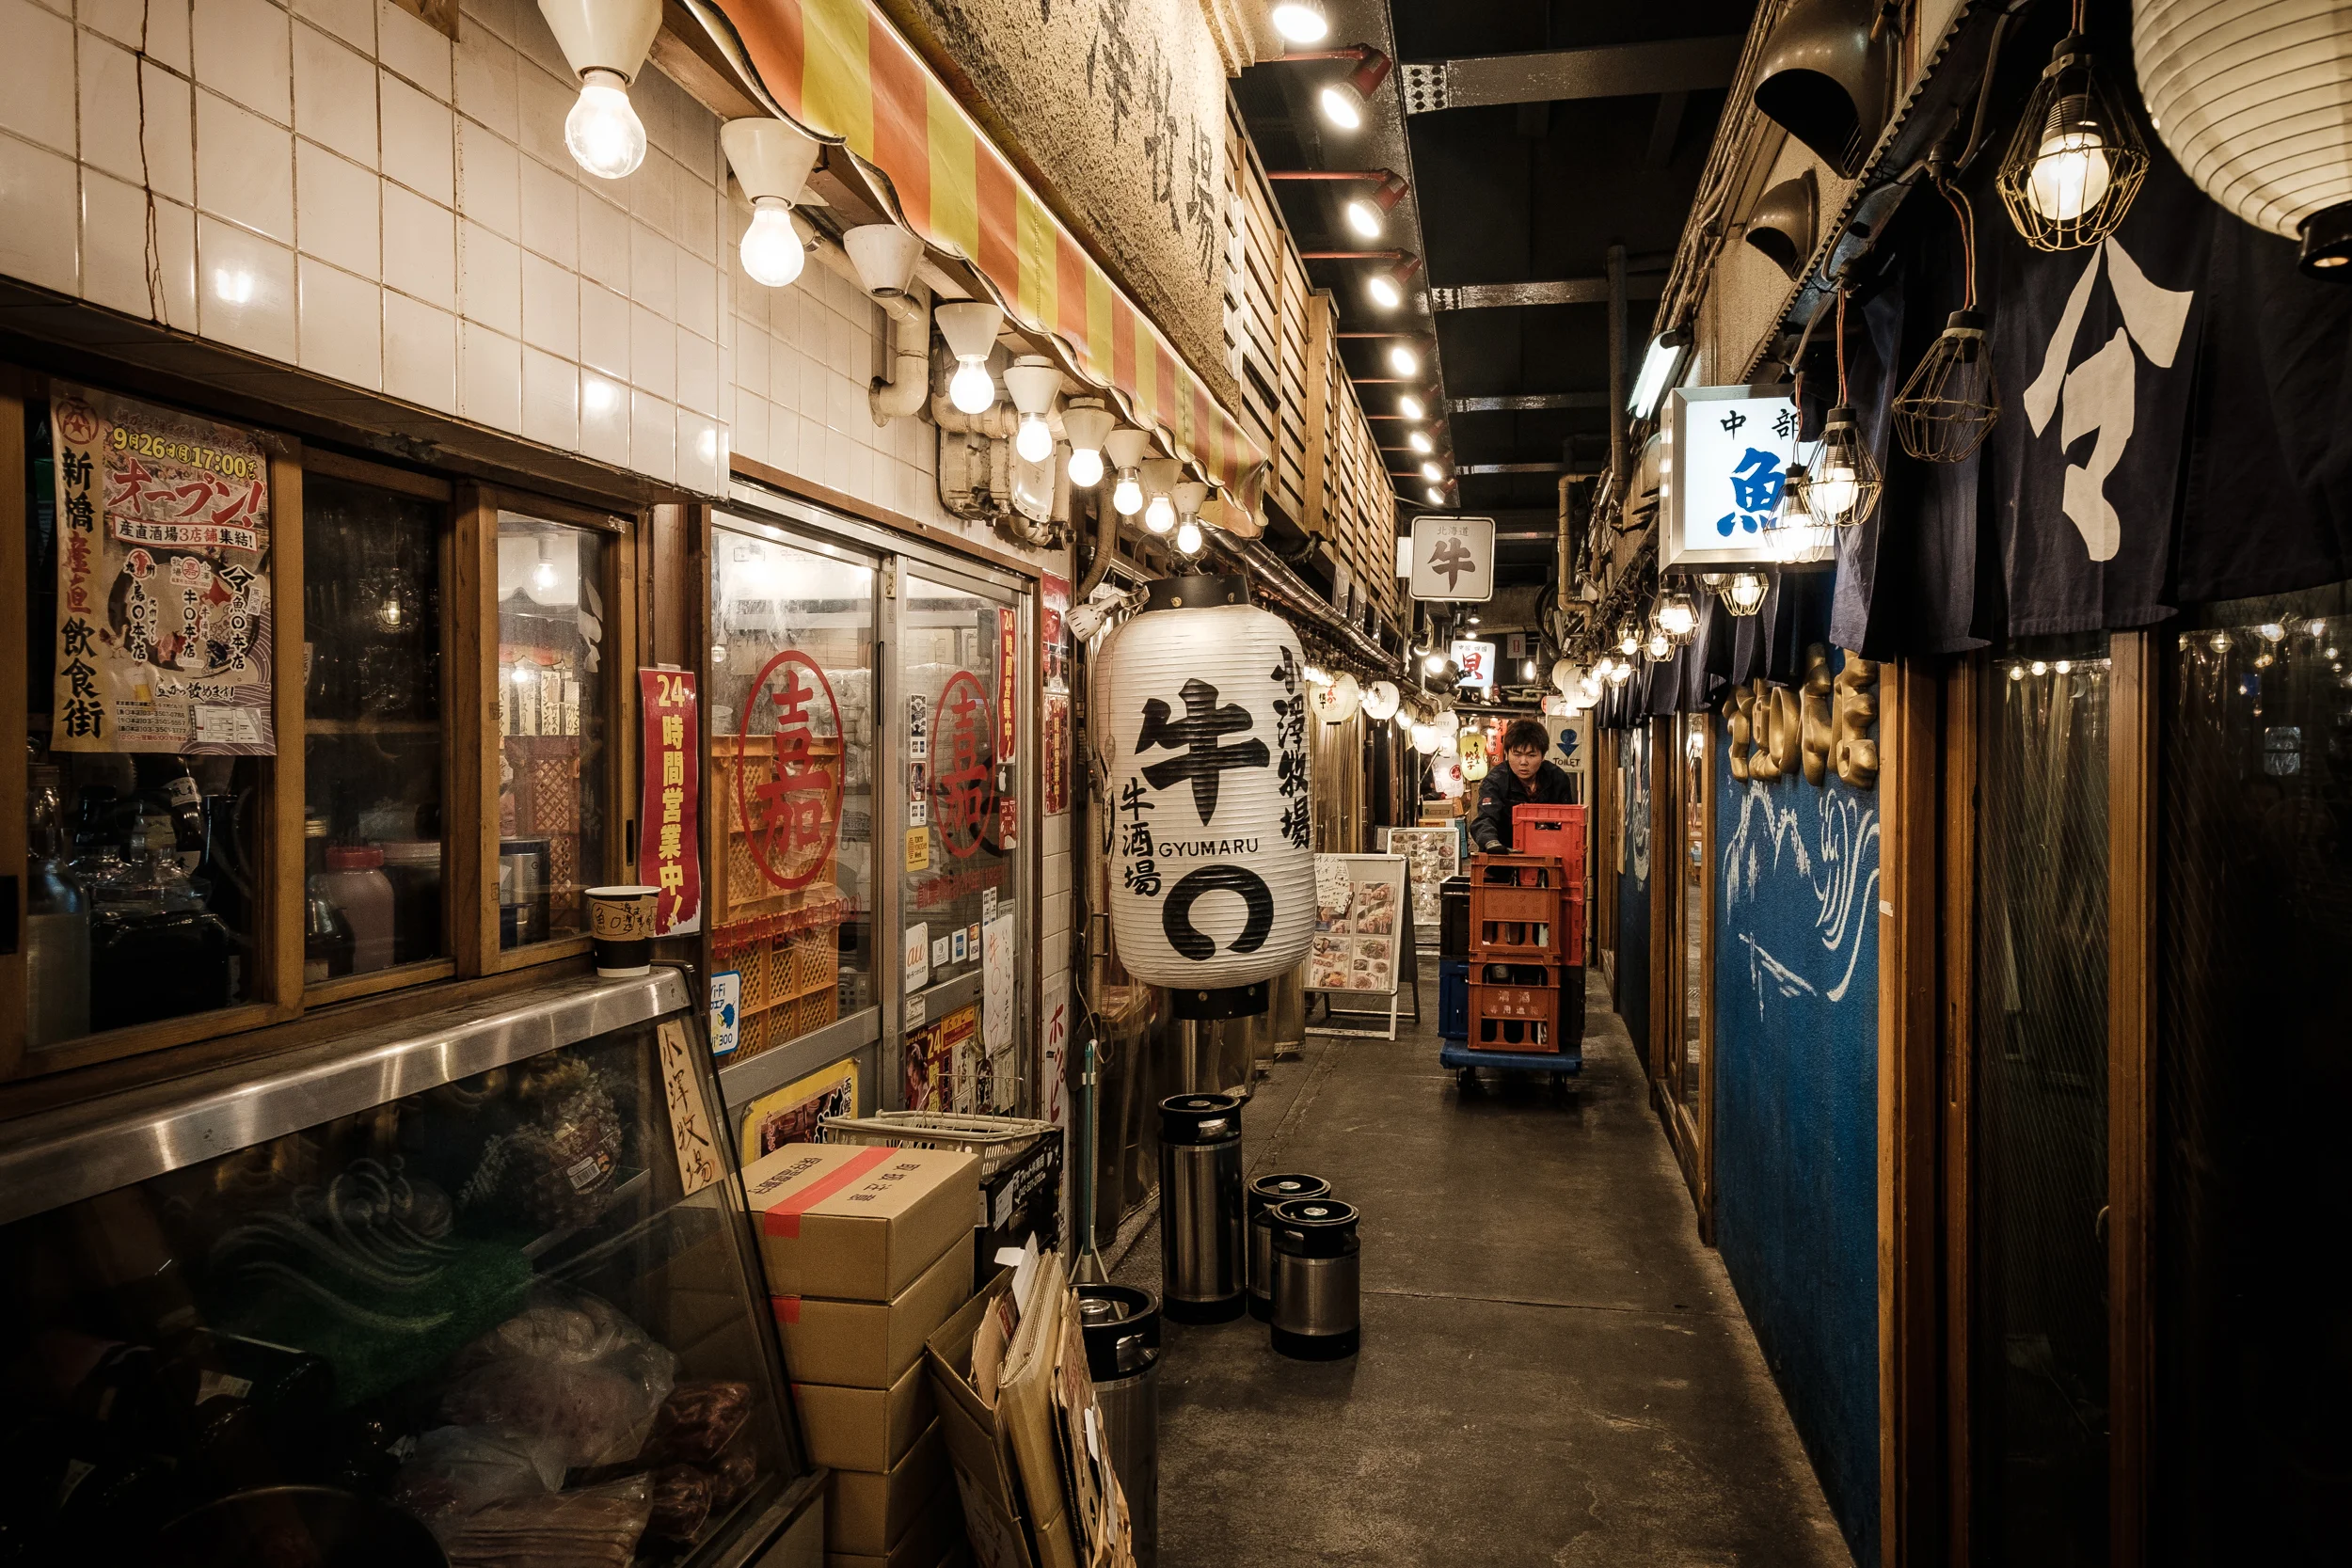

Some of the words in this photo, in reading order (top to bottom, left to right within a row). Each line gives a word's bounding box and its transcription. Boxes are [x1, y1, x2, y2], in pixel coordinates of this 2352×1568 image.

[1437, 526, 1470, 536] 北海道
[1716, 447, 1788, 537] 魚
[61, 446, 104, 738] 新橋産直飲食街
[1427, 537, 1476, 594] 牛
[1135, 677, 1270, 826] 牛
[1270, 645, 1311, 850] 小澤牧場
[1553, 757, 1581, 768] TOILET
[657, 674, 686, 928] 24時間営業中!
[1120, 777, 1162, 896] 牛酒場
[1158, 837, 1260, 858] GYUMARU
[907, 943, 924, 968] au
[662, 1028, 715, 1190] 小澤牧場
